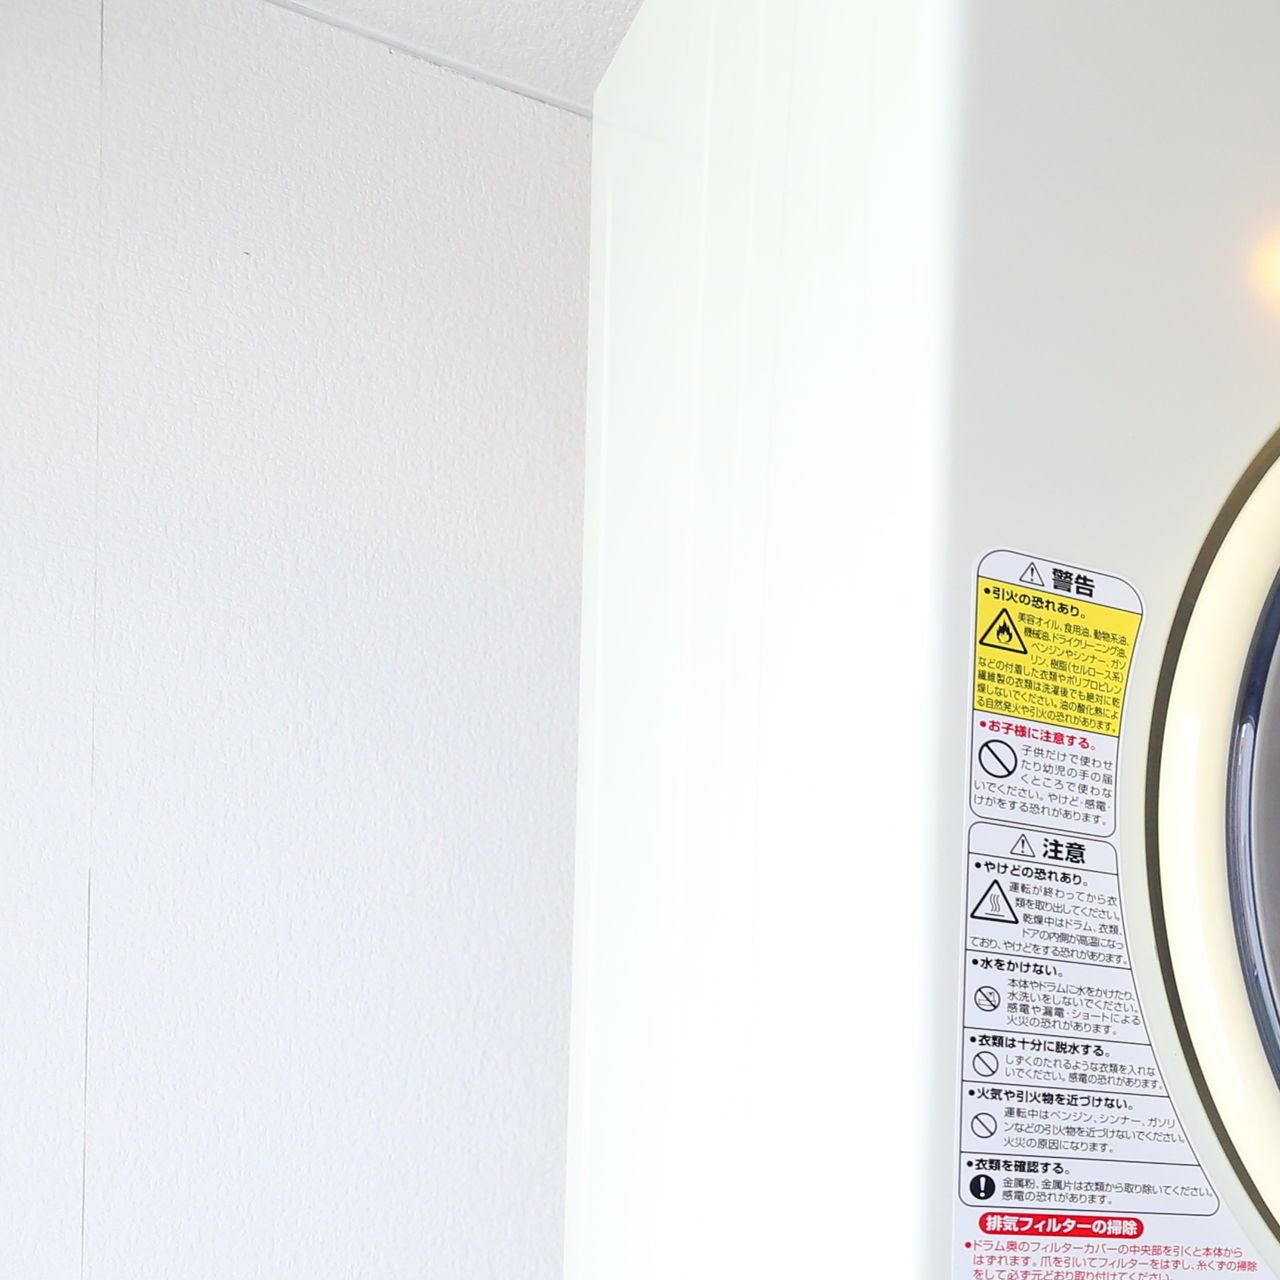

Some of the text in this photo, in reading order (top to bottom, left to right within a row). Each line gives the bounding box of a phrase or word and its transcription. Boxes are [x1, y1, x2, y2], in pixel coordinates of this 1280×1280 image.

[1052, 568, 1095, 597] 警告
[1022, 745, 1113, 770] 子供だけで使わせ
[1021, 760, 1113, 785] たり幼児の手の届
[1021, 774, 1112, 798] くところで使わな
[1042, 838, 1086, 864] 注意
[1009, 882, 1117, 906] 運転が終わってから衣
[986, 1215, 1138, 1236] 排気フィルターの掃除
